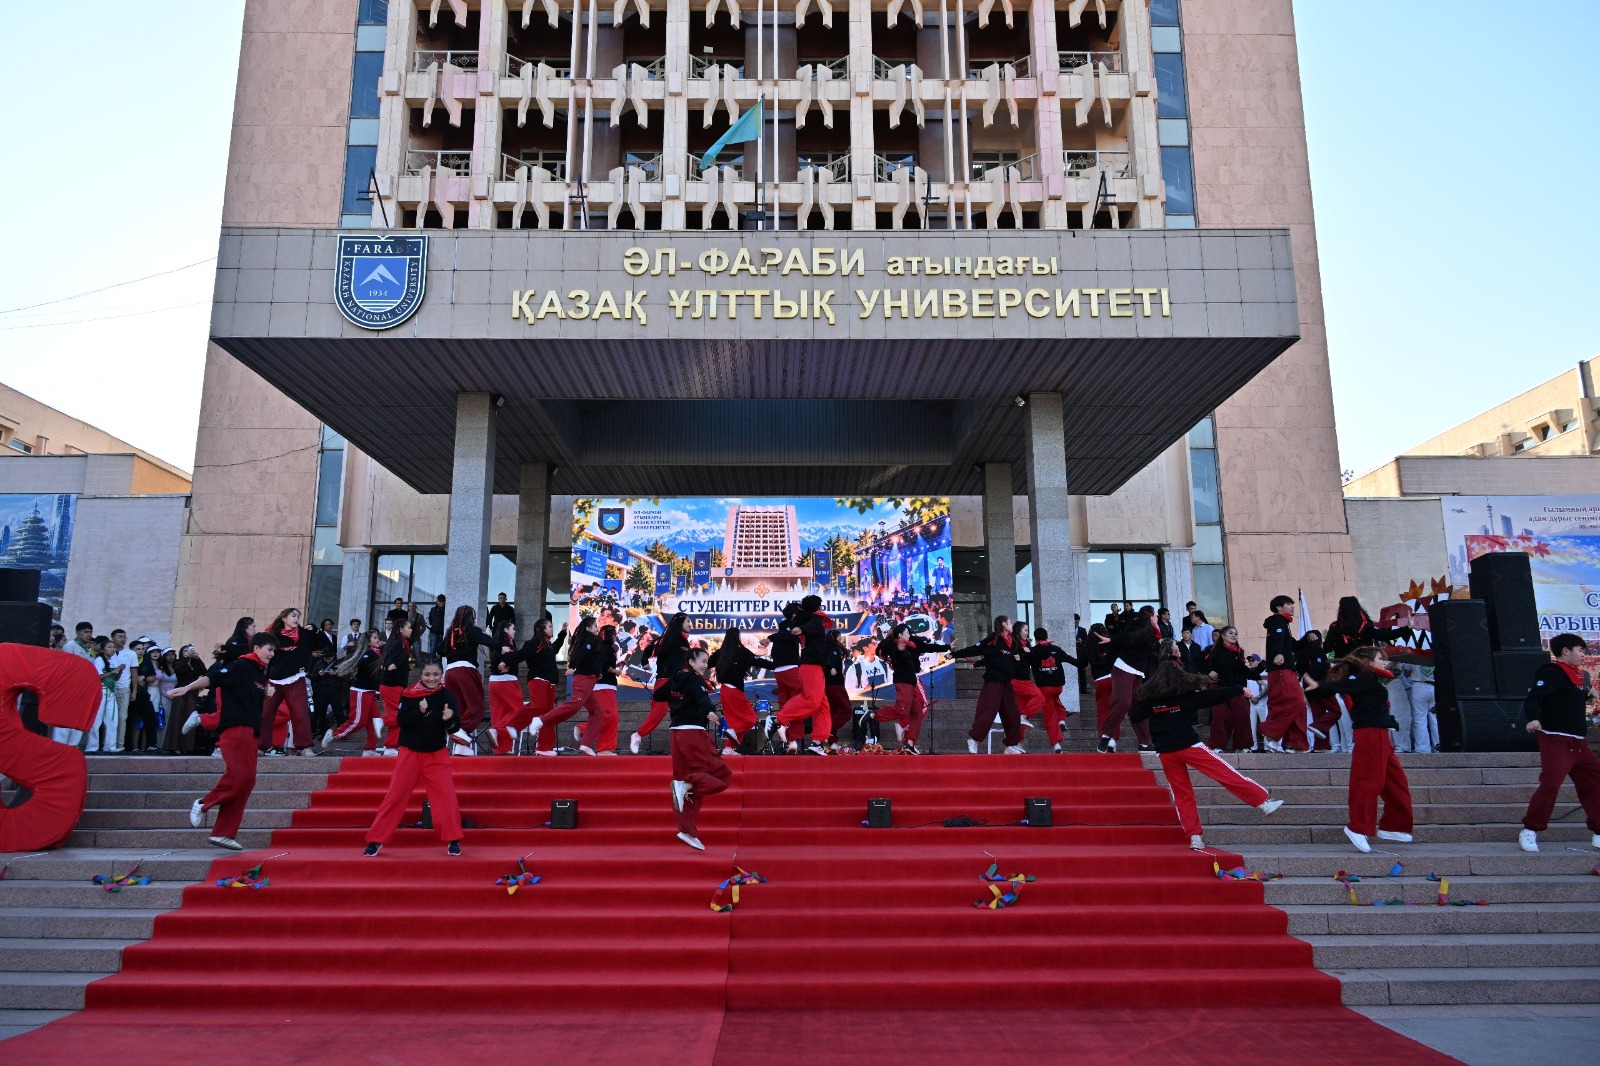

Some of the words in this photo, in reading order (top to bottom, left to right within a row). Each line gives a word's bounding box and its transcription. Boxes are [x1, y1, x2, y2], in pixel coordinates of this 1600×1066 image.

[623, 246, 866, 277] ӘЛ-ФАРАБИ
[886, 255, 1059, 279] атындағы
[342, 260, 352, 299] KAZAKH
[368, 289, 388, 297] 1934
[395, 261, 418, 314] UNIVERSITY
[346, 300, 394, 321] NATIONAL
[511, 289, 648, 326] ҚАЗАҚ
[668, 289, 836, 326] ҰЛТТЫҚ
[855, 287, 1171, 319] УНИВЕРСИТЕТІ
[677, 600, 770, 614] СТУДЕНТТЕР
